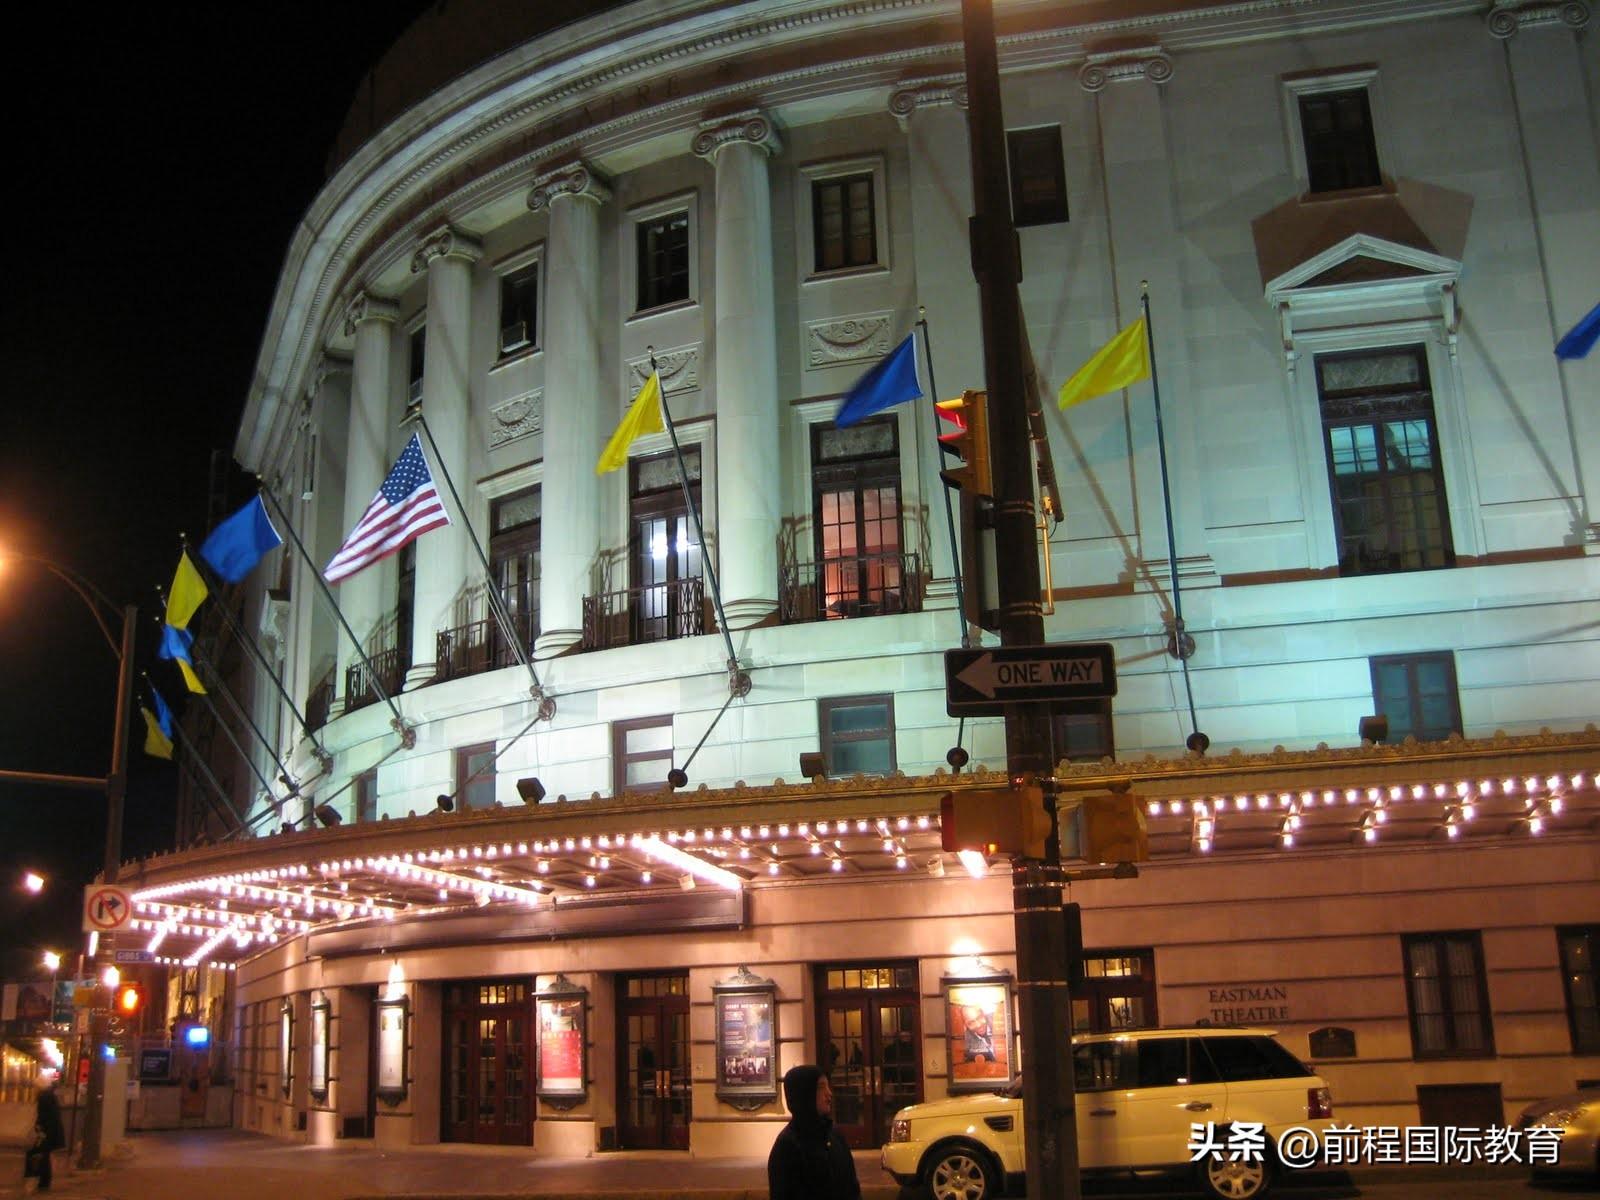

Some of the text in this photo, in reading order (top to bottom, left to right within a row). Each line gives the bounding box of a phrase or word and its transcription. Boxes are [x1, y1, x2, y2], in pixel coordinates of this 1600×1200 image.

[998, 660, 1095, 684] ONE WAY
[1208, 987, 1287, 1003] EASTMAN
[1210, 1006, 1289, 1022] THEATRE
